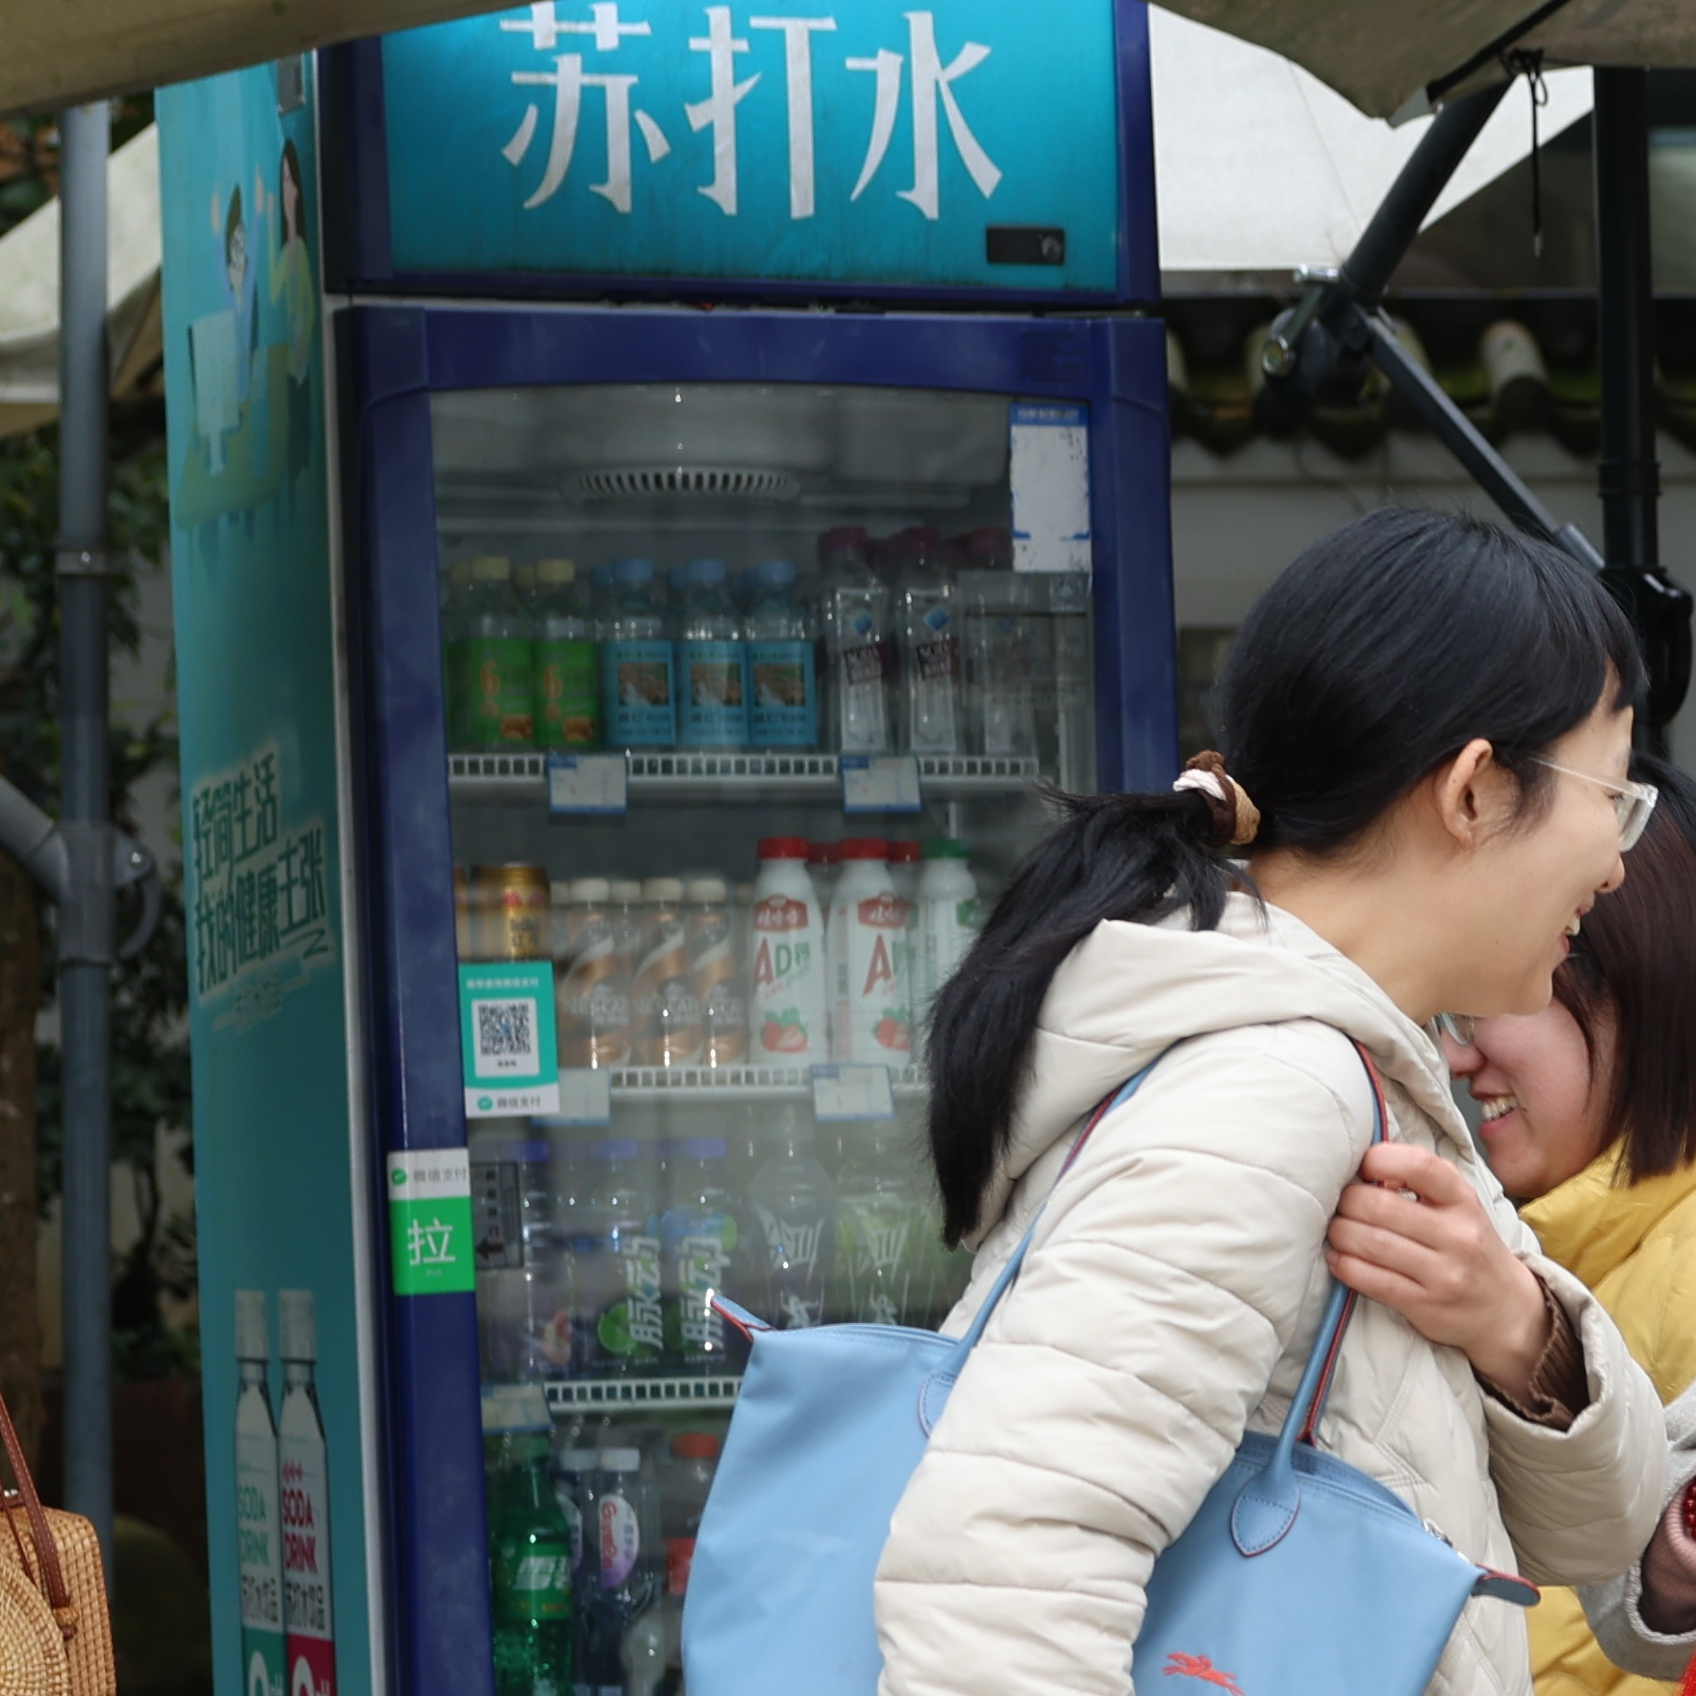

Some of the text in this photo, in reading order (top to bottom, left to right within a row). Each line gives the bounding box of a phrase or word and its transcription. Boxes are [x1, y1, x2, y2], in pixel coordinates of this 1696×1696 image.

[498, 0, 1004, 221] 苏打水
[414, 1167, 467, 1184] 微信支付
[407, 1218, 457, 1267] 拉
